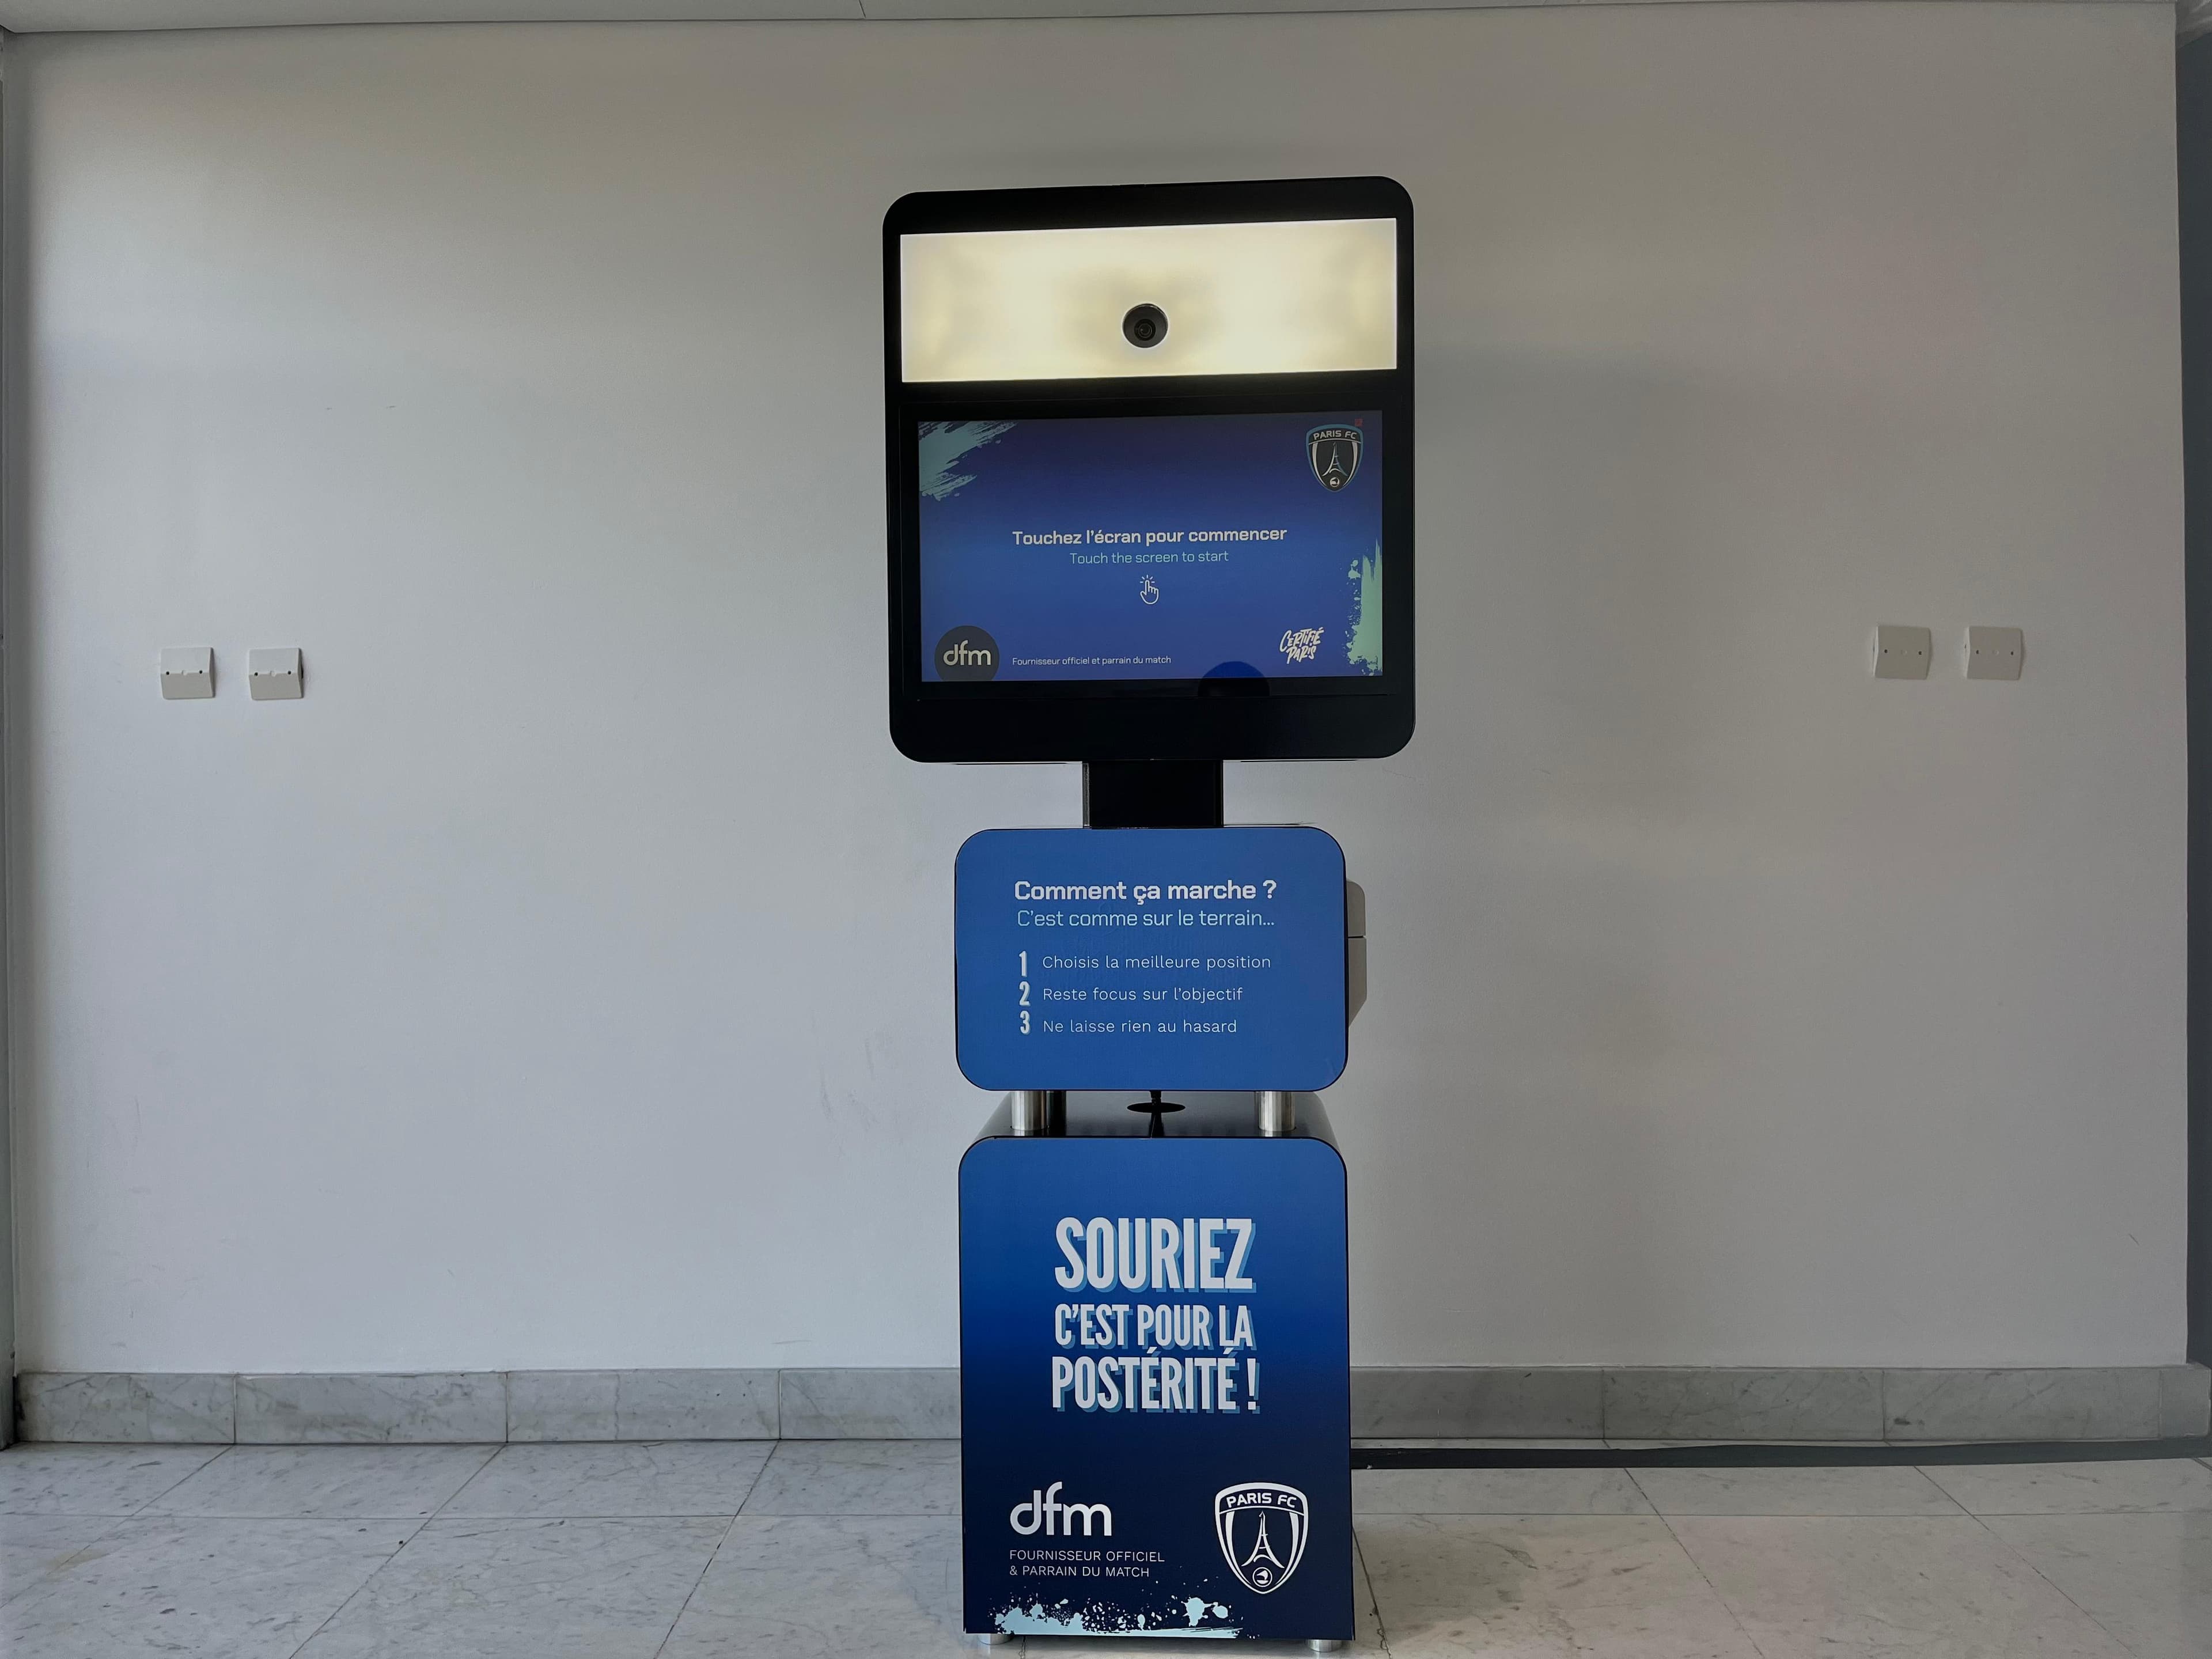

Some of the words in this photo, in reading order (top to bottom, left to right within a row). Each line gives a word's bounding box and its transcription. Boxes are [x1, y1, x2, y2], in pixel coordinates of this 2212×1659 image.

[1313, 430, 1342, 440] PARIS
[1345, 431, 1357, 439] FC
[1012, 531, 1081, 545] Touchez
[1086, 530, 1141, 544] l'écran
[1146, 531, 1184, 547] pour
[1188, 528, 1287, 543] commencer
[1070, 552, 1108, 564] Touch
[1111, 552, 1132, 563] the
[1135, 552, 1178, 563] screen
[1181, 552, 1195, 562] to
[1198, 551, 1229, 562] start
[943, 639, 991, 665] dfm
[1013, 657, 1060, 665] Fournisseur
[1102, 657, 1131, 666] parrain
[1133, 656, 1143, 664] du
[1145, 656, 1171, 664] match
[1286, 645, 1316, 664] PARIS
[1014, 881, 1127, 900] Comment
[1134, 885, 1160, 905] ça
[1168, 880, 1256, 899] marche
[1263, 880, 1277, 899] ?
[1017, 910, 1063, 926] C'est
[1069, 912, 1138, 926] comme
[1143, 912, 1173, 926] sur
[1178, 909, 1194, 926] le
[1199, 910, 1275, 926] terrain...
[1019, 950, 1028, 977] 1
[1043, 955, 1099, 968] Choisis
[1106, 956, 1119, 968] la
[1126, 956, 1200, 968] meilleure
[1207, 956, 1271, 971] position
[1019, 981, 1031, 1006] 2
[1043, 988, 1086, 1001] Reste
[1093, 987, 1136, 1001] focus
[1143, 990, 1168, 1001] sur
[1174, 987, 1243, 1003] l'objectif
[1019, 1010, 1031, 1035] 3
[1043, 1021, 1063, 1032] Ne
[1070, 1020, 1115, 1032] laisse
[1122, 1021, 1151, 1032] rien
[1158, 1022, 1176, 1032] au
[1183, 1020, 1237, 1032] hasard
[1055, 1217, 1256, 1293] SOURIEZ
[1055, 1304, 1133, 1349] C'EST
[1137, 1304, 1213, 1349] POUR
[1219, 1305, 1257, 1350] LA
[1052, 1347, 1240, 1413] POSTÉRITÉ
[1247, 1358, 1259, 1412] !
[1010, 1482, 1112, 1536] dfm
[1226, 1493, 1272, 1508] PARIS
[1278, 1495, 1297, 1508] FC
[1010, 1550, 1101, 1561] FOURNISSEUR
[1106, 1551, 1165, 1562] OFFICIEL
[1010, 1566, 1017, 1575] &
[1023, 1566, 1076, 1576] PARRAIN
[1082, 1567, 1100, 1576] DU
[1106, 1567, 1149, 1577] MATCH
